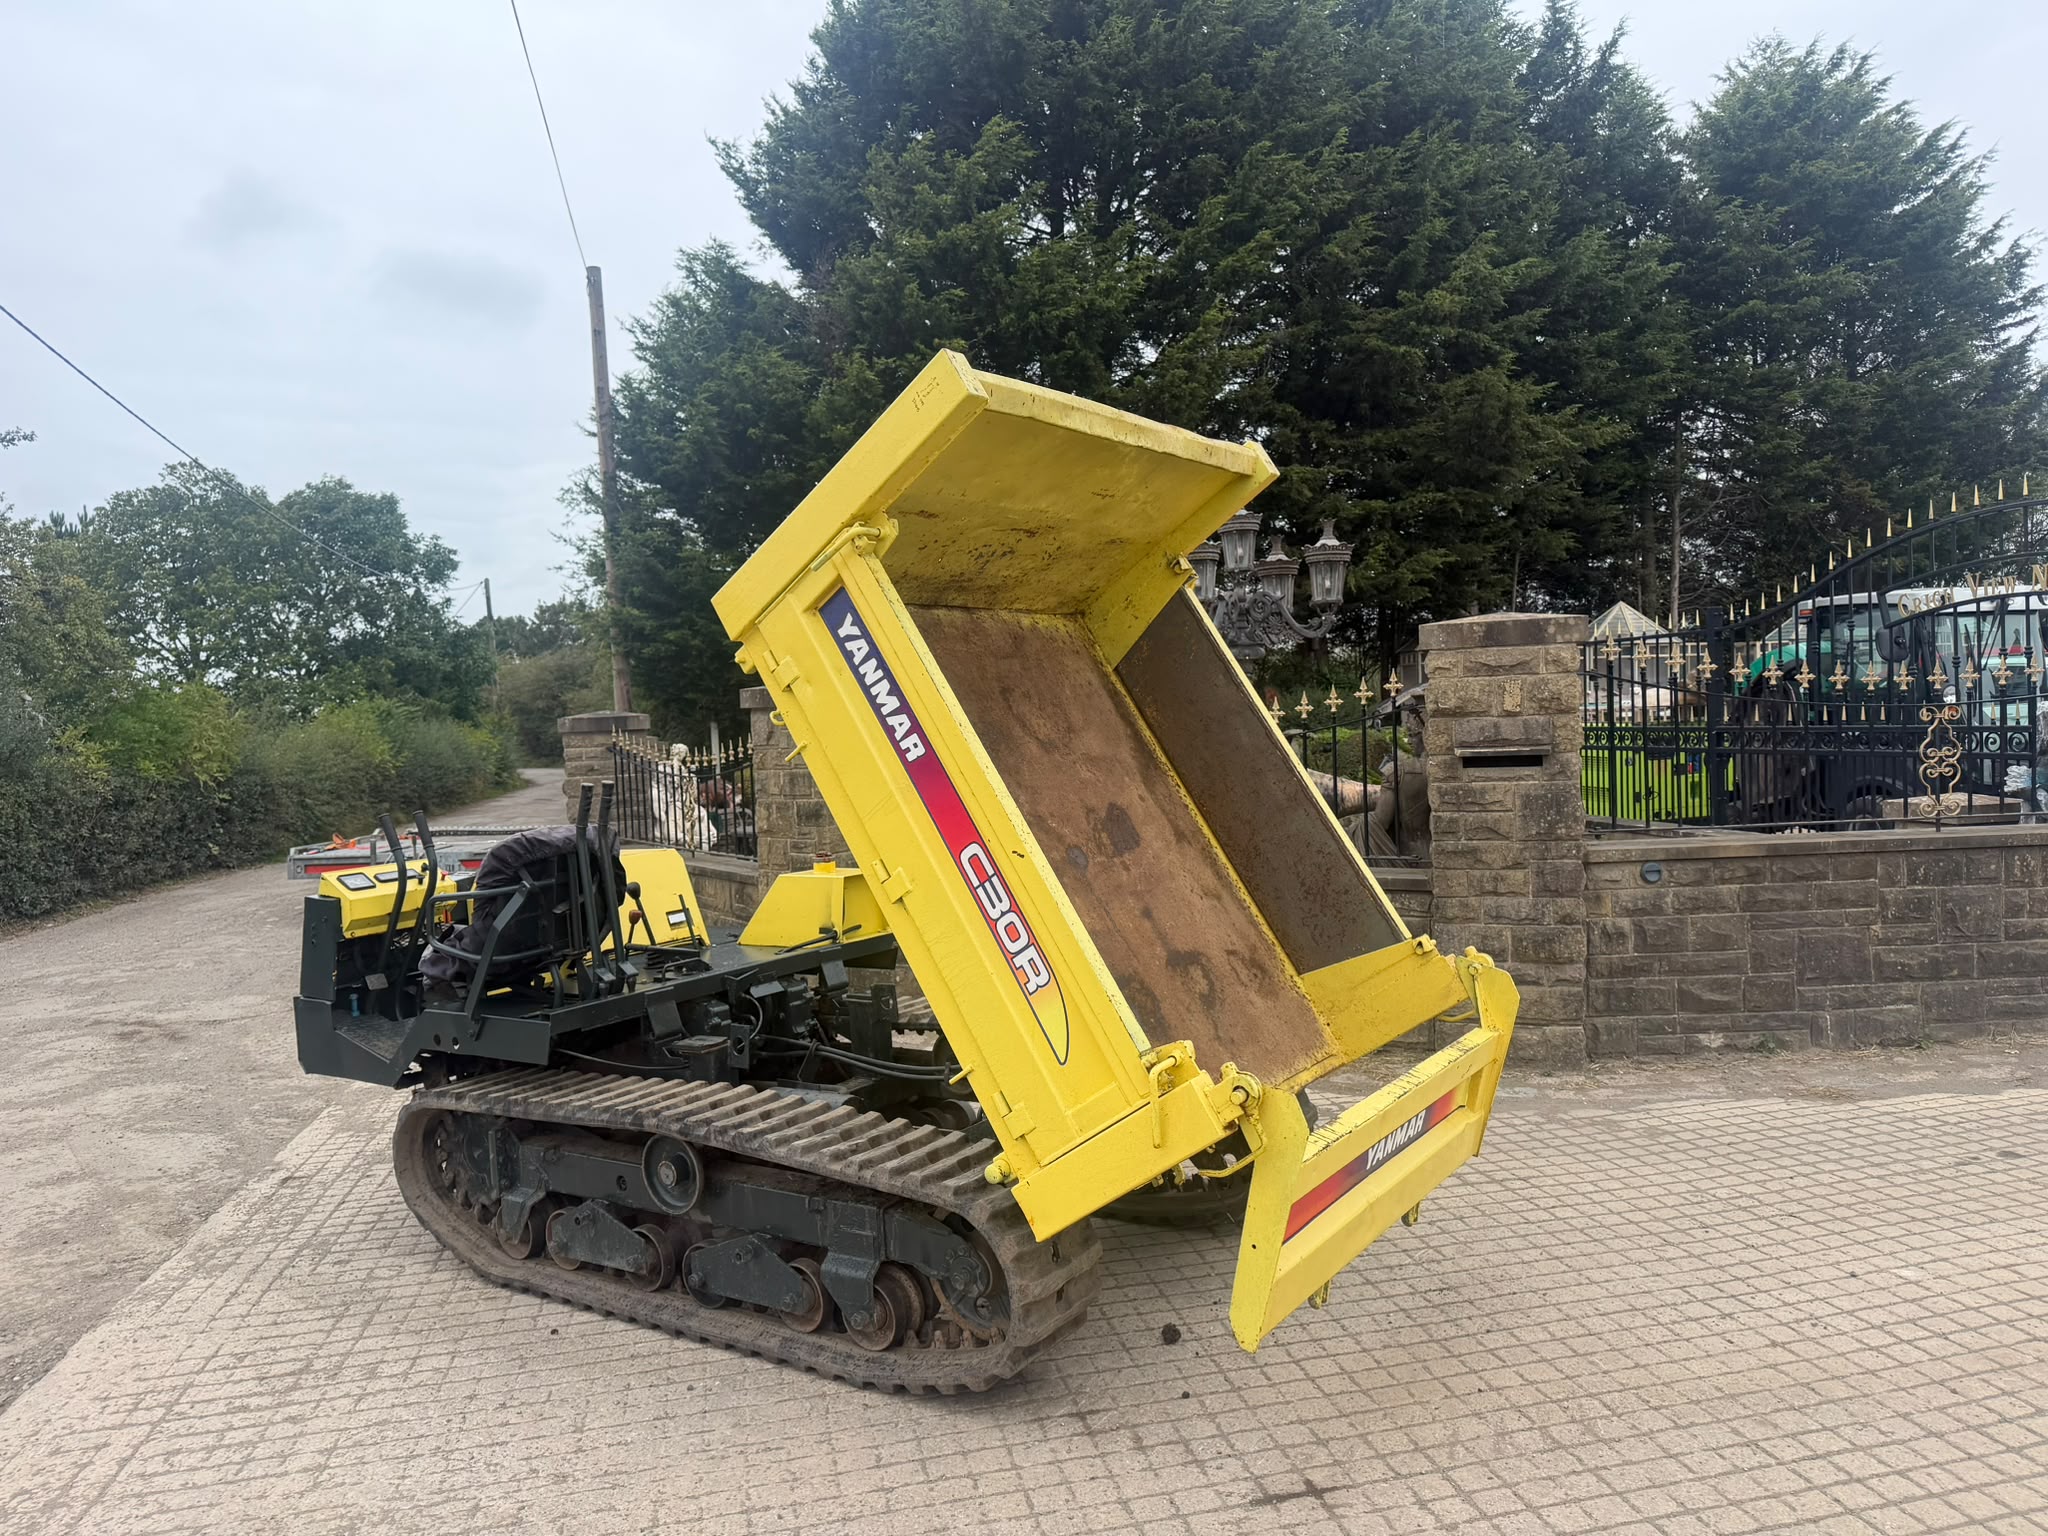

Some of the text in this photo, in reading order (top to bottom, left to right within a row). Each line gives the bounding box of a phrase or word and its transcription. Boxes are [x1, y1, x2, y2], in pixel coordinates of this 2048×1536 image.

[836, 612, 1050, 995] YANMAR C30R
[1366, 1109, 1426, 1170] YANMAR
